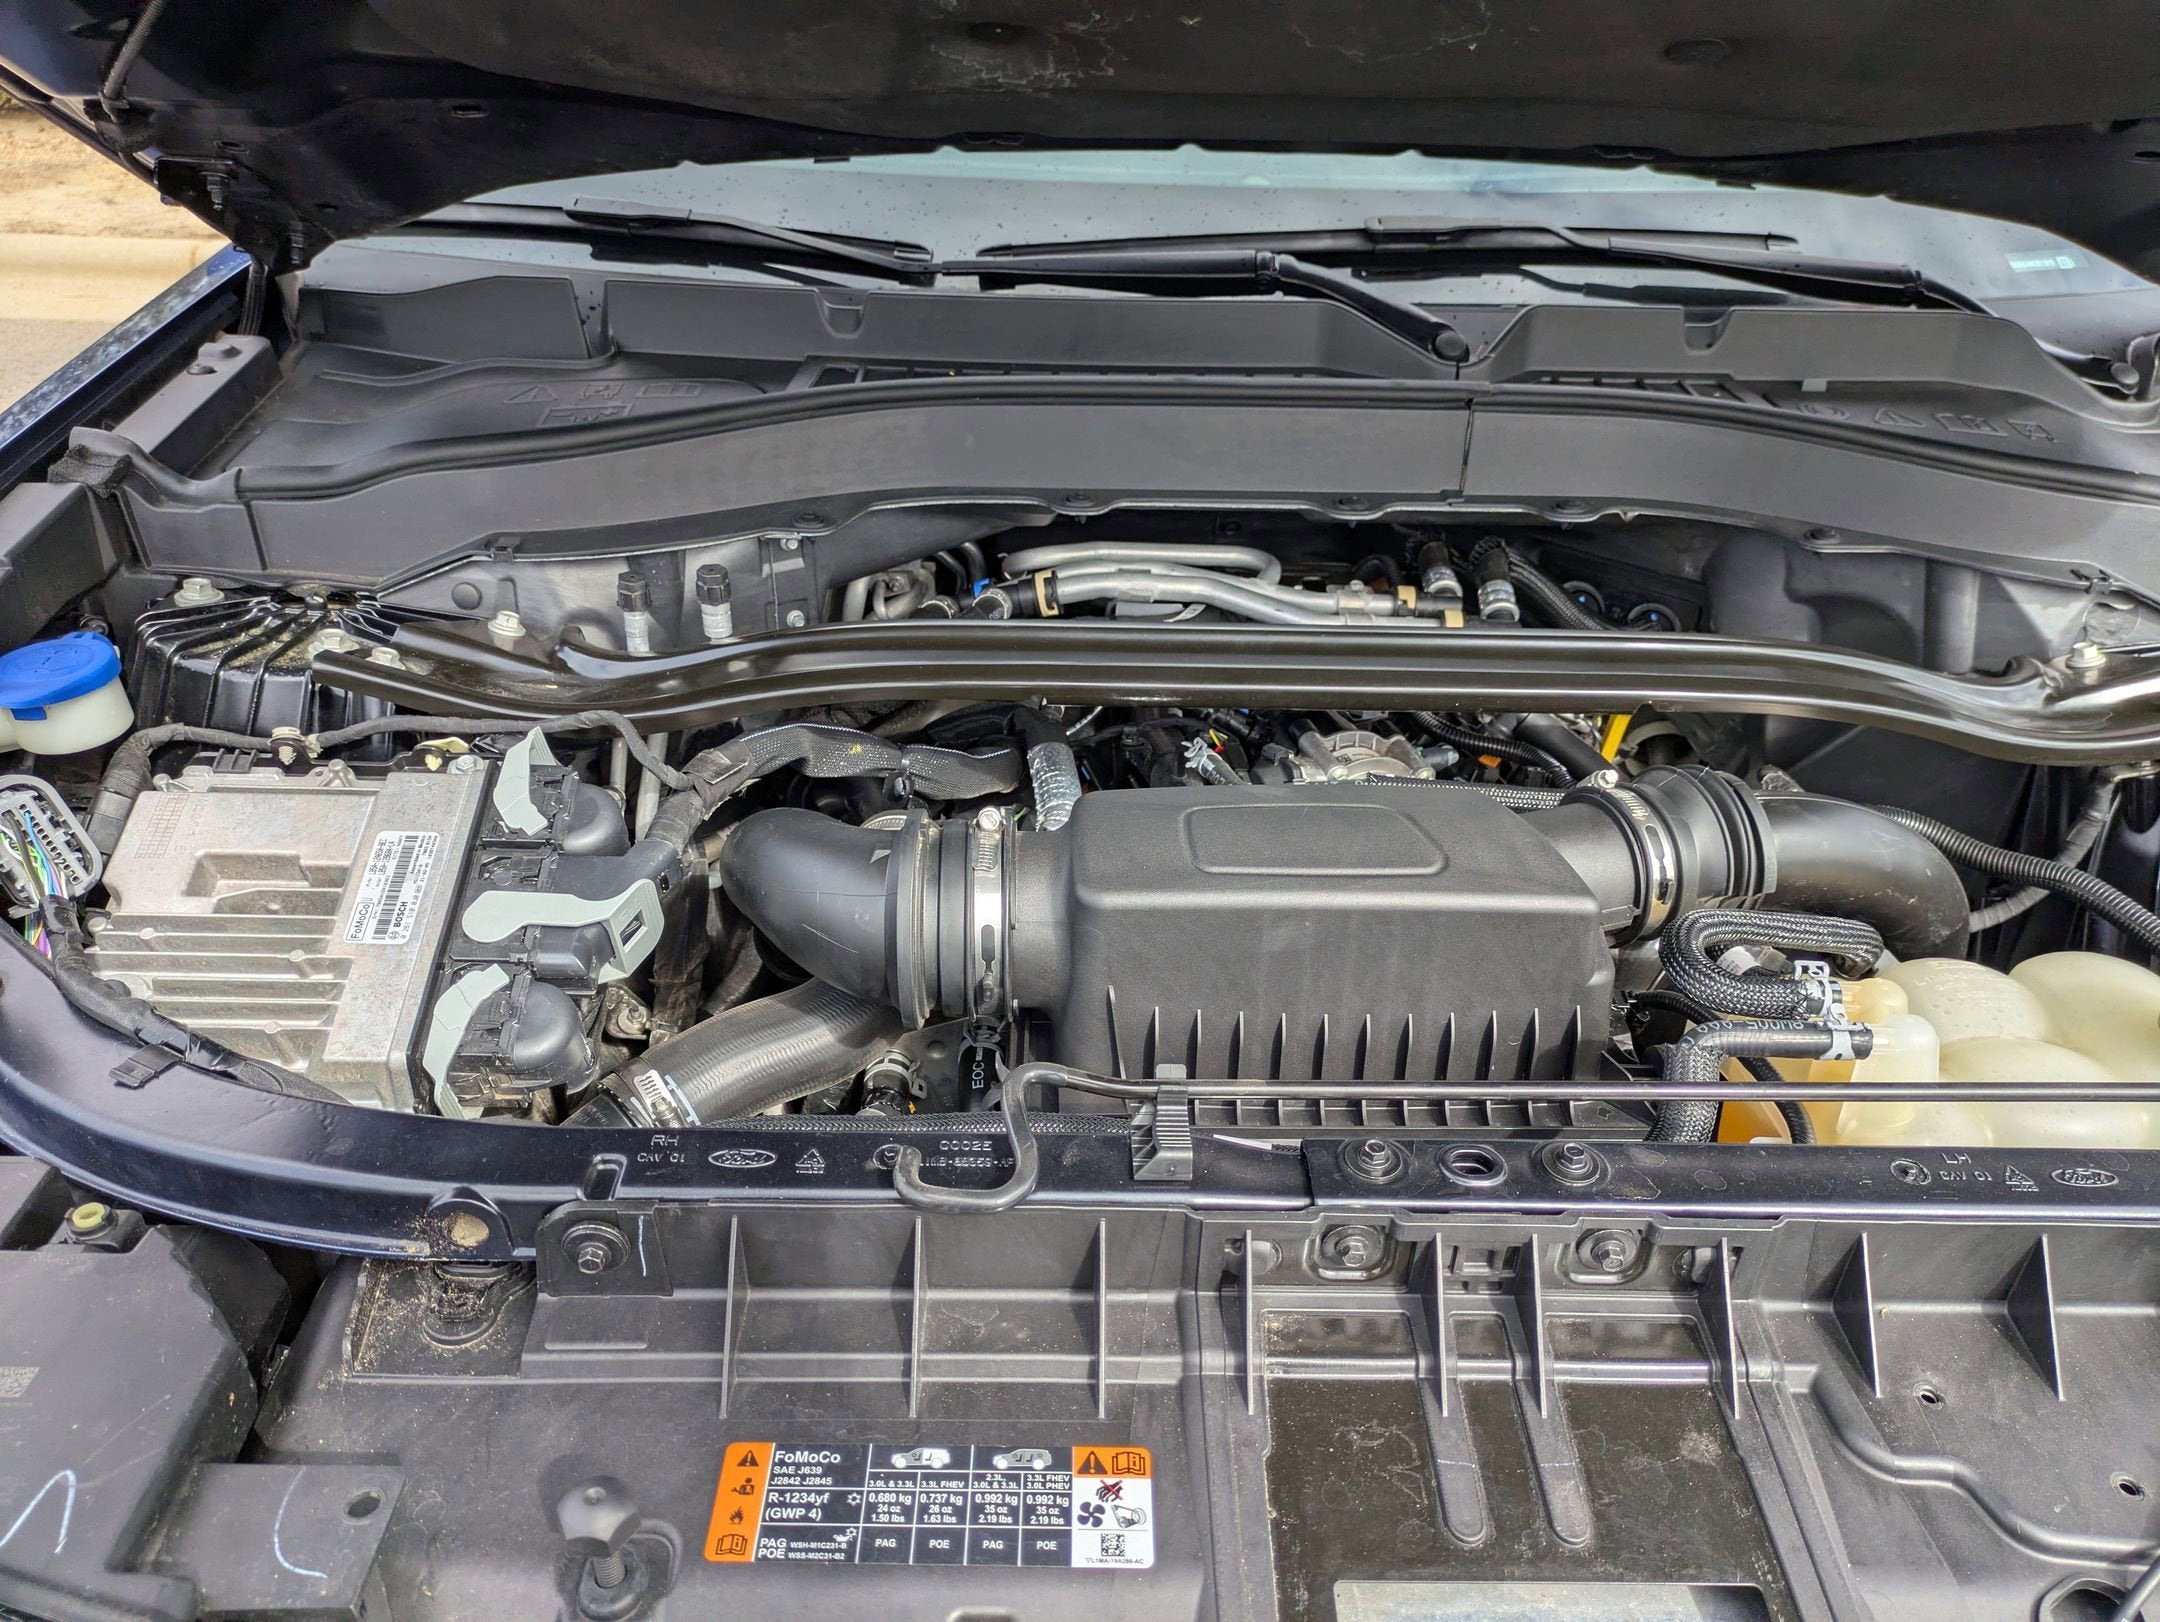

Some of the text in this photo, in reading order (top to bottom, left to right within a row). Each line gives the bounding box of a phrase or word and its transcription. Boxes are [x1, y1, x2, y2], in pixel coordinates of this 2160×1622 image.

[393, 901, 408, 928] BOSCH
[350, 904, 370, 939] FoMoCo
[971, 1062, 985, 1089] EOC
[651, 1135, 680, 1146] RH
[637, 1152, 662, 1163] CAV
[715, 1149, 771, 1167] Ford
[1941, 1152, 1972, 1165] LH
[1939, 1170, 1967, 1181] CAV
[2060, 1168, 2111, 1185] Ford
[774, 1450, 841, 1465] FoMoCo
[772, 1466, 822, 1475] SAE J639
[770, 1476, 833, 1486] J2842 J2845
[1026, 1474, 1070, 1482] 3.3L FHEV
[868, 1480, 915, 1488] 3.0L & 3.3L
[920, 1480, 964, 1489] 3.3L FHEV
[972, 1481, 1019, 1489] 3.0L & 3.3L
[1026, 1481, 1071, 1490] 3.0L PHEV
[768, 1492, 830, 1506] R-1234yf
[868, 1493, 912, 1505] 0.680 kg
[919, 1493, 963, 1505] 0.737 kg
[975, 1494, 1018, 1506] 0.992 kg
[1026, 1494, 1070, 1507] 0.992 kg
[877, 1504, 889, 1513] 24
[928, 1505, 953, 1514] 26 oz
[984, 1506, 996, 1514] 35
[1036, 1507, 1048, 1515] 35
[765, 1508, 823, 1521] (GWP 4)
[871, 1514, 905, 1522] 1.50 lbs
[923, 1515, 957, 1523] 1.63 lbs
[978, 1515, 1013, 1524] 2.19 lbs
[1030, 1516, 1065, 1525] 2.19 lbs
[760, 1537, 787, 1548] PAG
[874, 1538, 897, 1547] PAG
[928, 1539, 950, 1549] POE
[982, 1540, 1004, 1549] PAG
[1036, 1541, 1057, 1550] POE
[757, 1548, 786, 1559] POE
